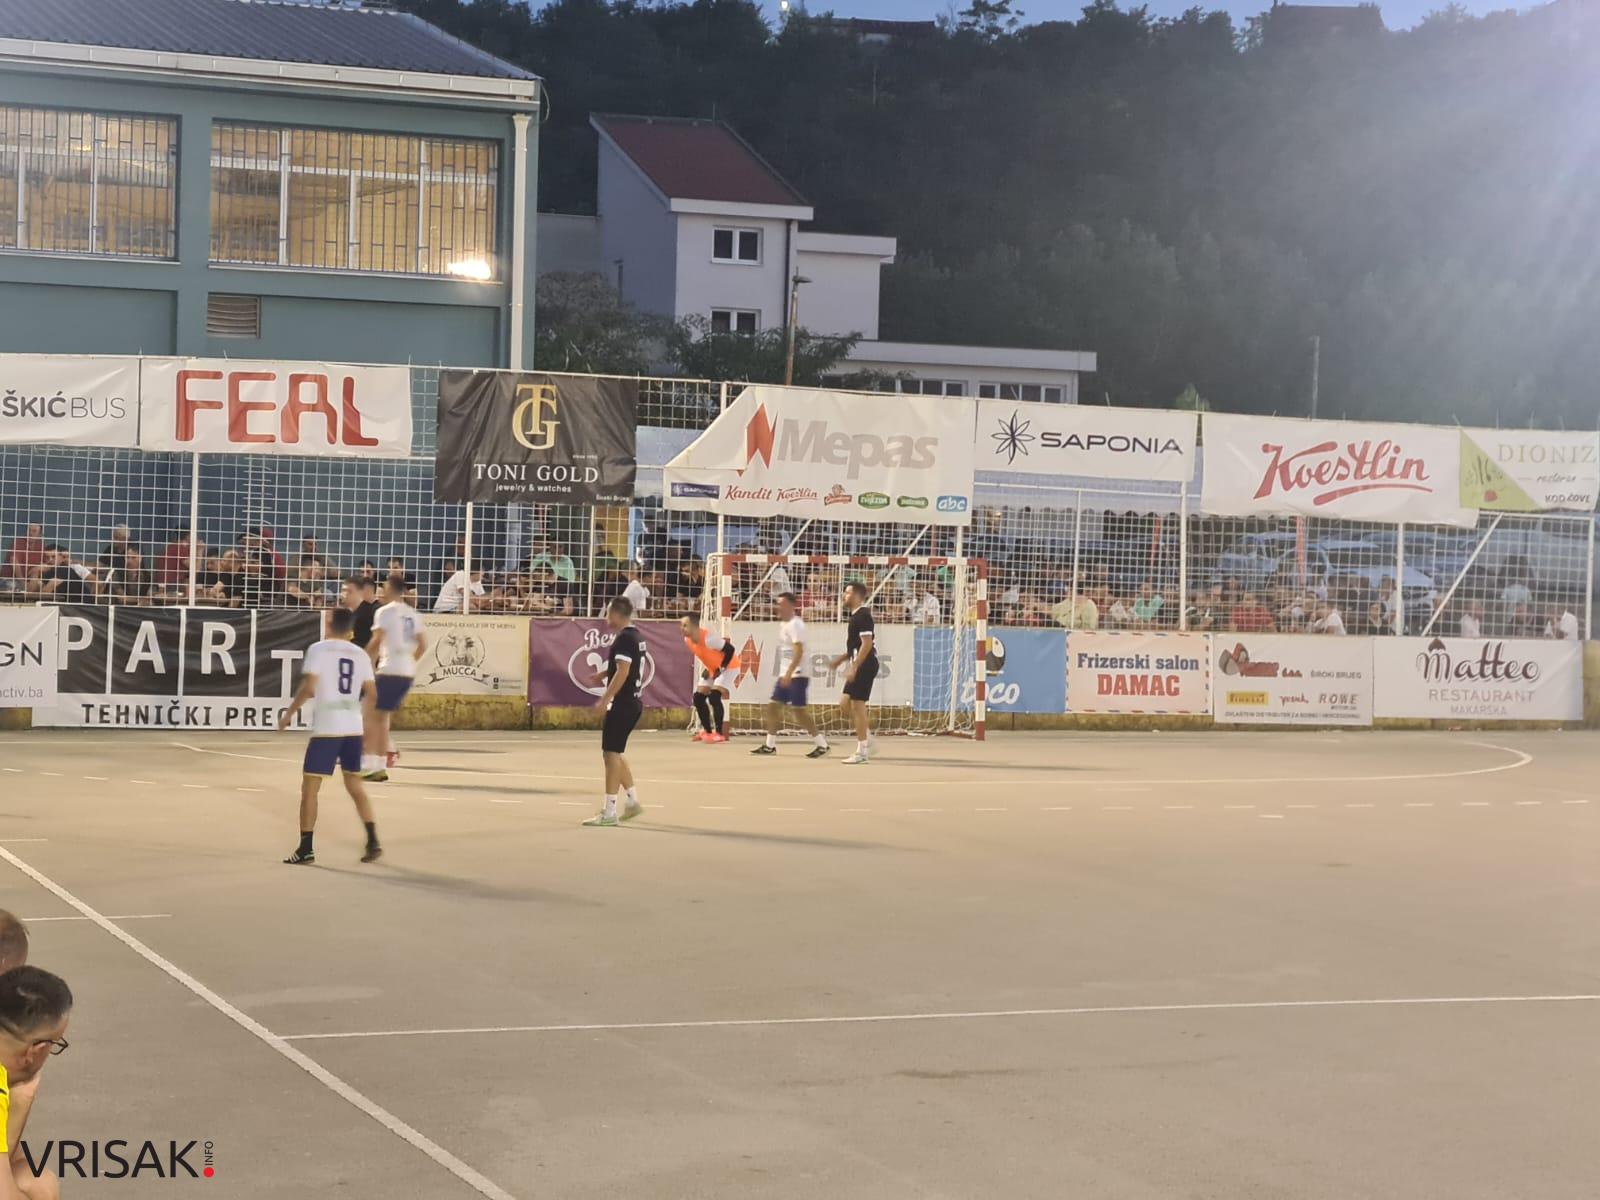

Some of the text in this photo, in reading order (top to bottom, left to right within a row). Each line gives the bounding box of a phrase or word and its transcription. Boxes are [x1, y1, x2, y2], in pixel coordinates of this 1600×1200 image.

[175, 370, 379, 446] FEAL
[777, 418, 939, 480] Mepas
[1041, 431, 1184, 455] SAPONIA
[474, 463, 599, 482] TONI GOLD
[1253, 439, 1432, 506] Koestlin
[495, 483, 525, 493] jewelry
[537, 484, 572, 493] watches
[725, 485, 772, 500] Kandit
[937, 497, 966, 510] abc
[1077, 652, 1200, 671] Frizerski salon
[1416, 640, 1541, 684] Matteo
[338, 657, 355, 694] 8
[442, 666, 477, 677] MUCCA
[0, 685, 43, 698] ctiv.ba
[1097, 674, 1181, 697] DAMAC
[1429, 688, 1535, 703] RESTAURANT
[81, 699, 212, 726] TEHNIČKI
[1450, 704, 1508, 716] MAKARSKA
